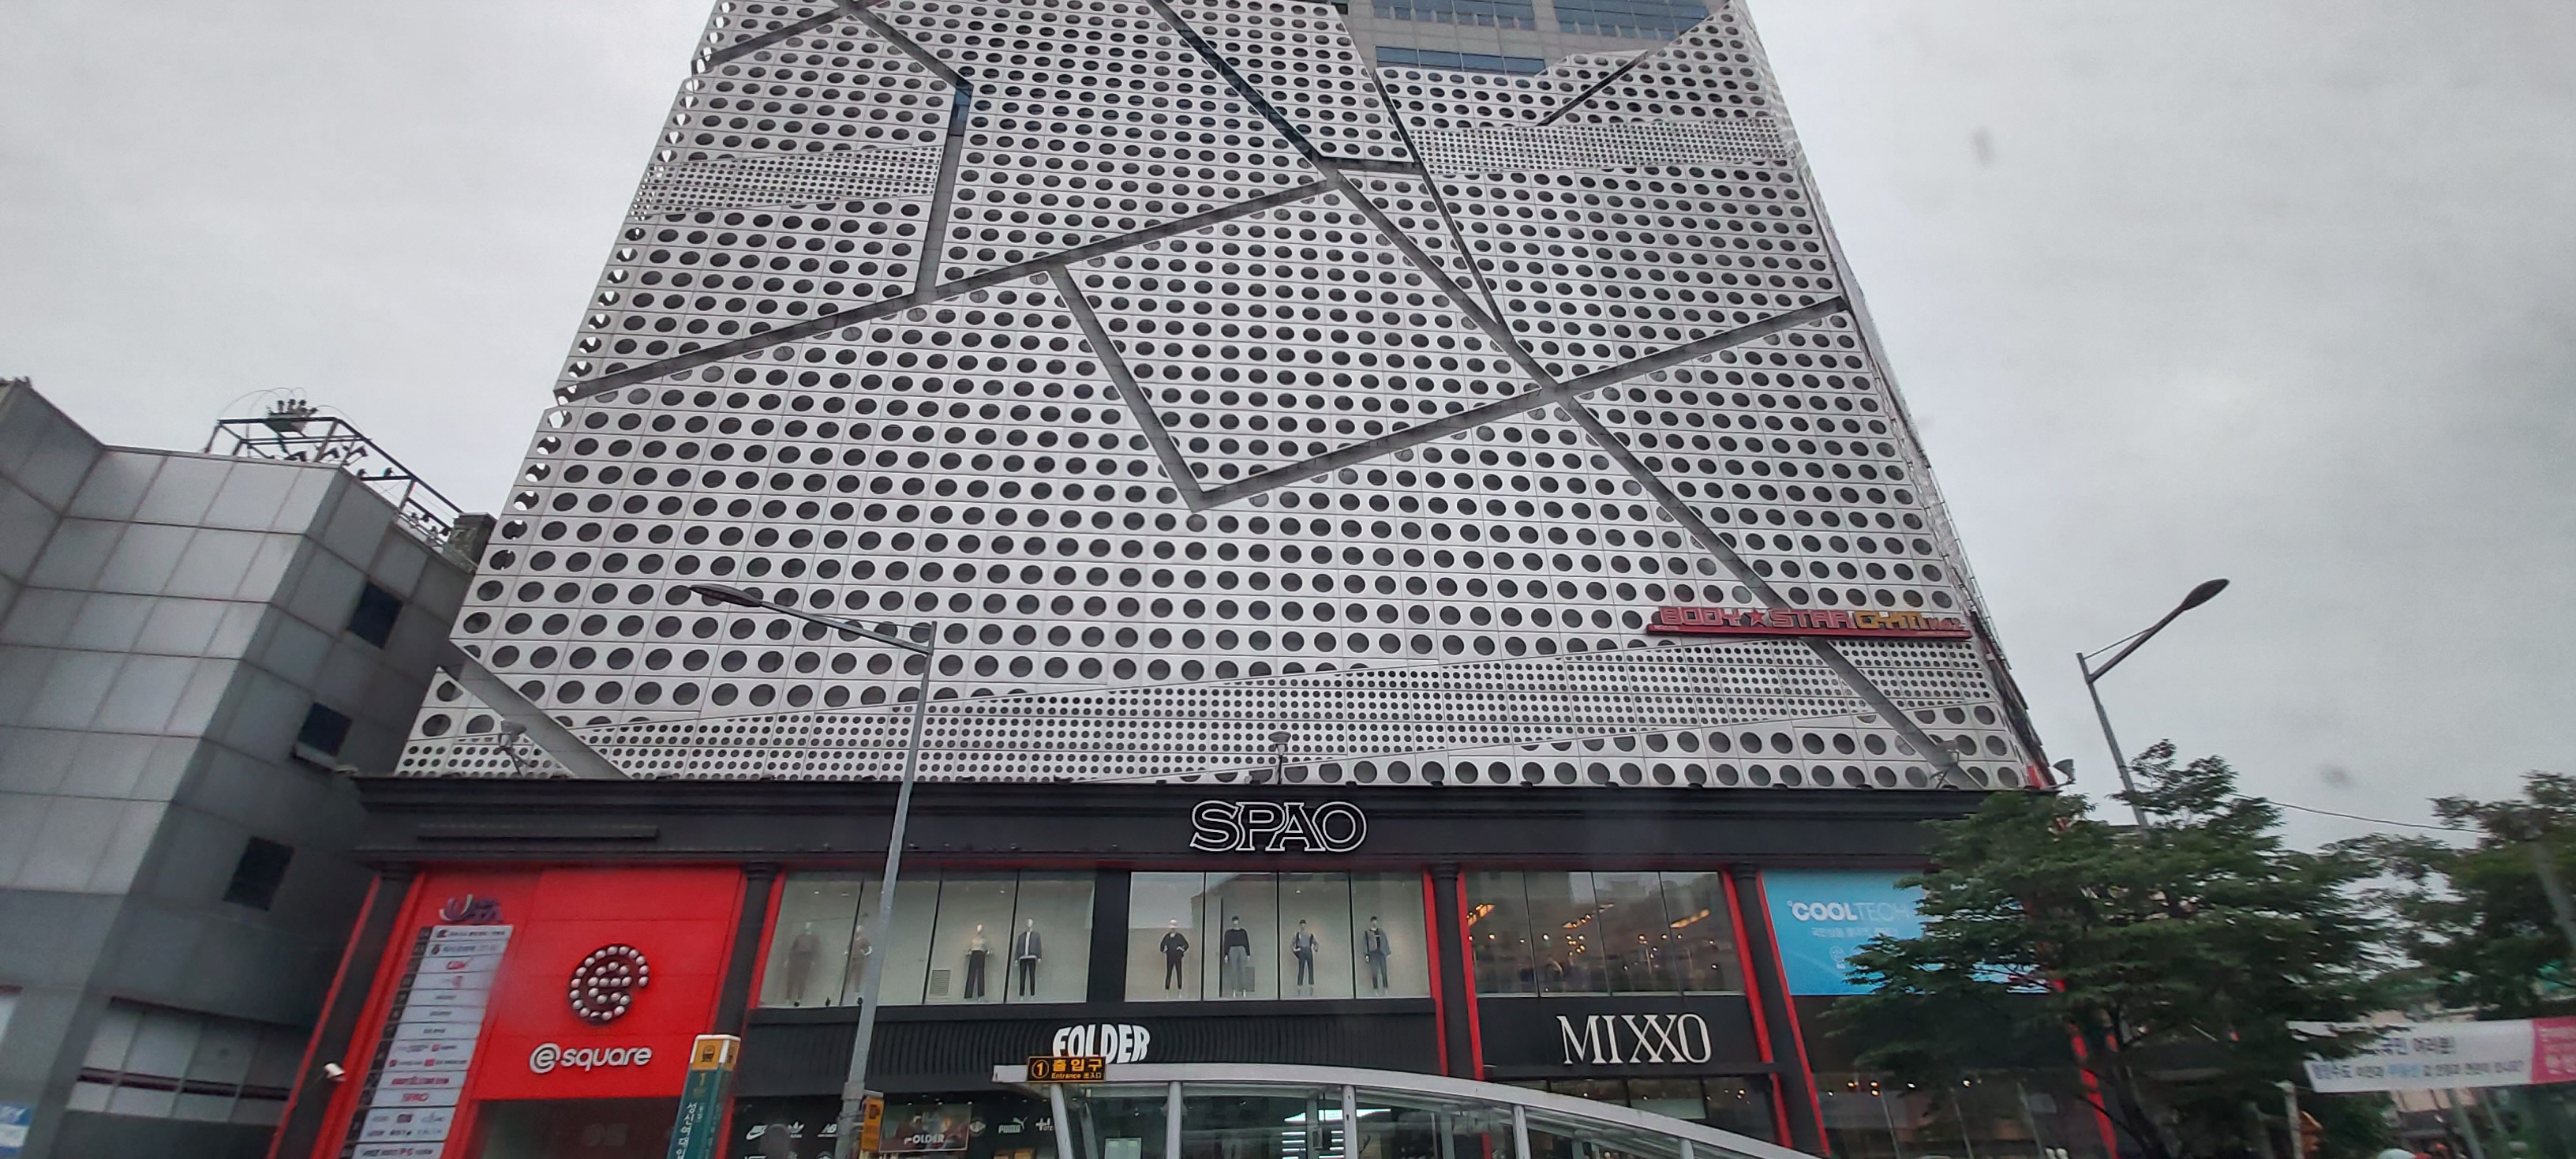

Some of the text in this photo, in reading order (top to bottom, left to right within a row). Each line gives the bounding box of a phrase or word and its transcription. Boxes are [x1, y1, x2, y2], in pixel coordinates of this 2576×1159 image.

[1189, 800, 1368, 852] SPAO
[1052, 1024, 1151, 1064] FOLDER
[1053, 1059, 1103, 1071] 출입구
